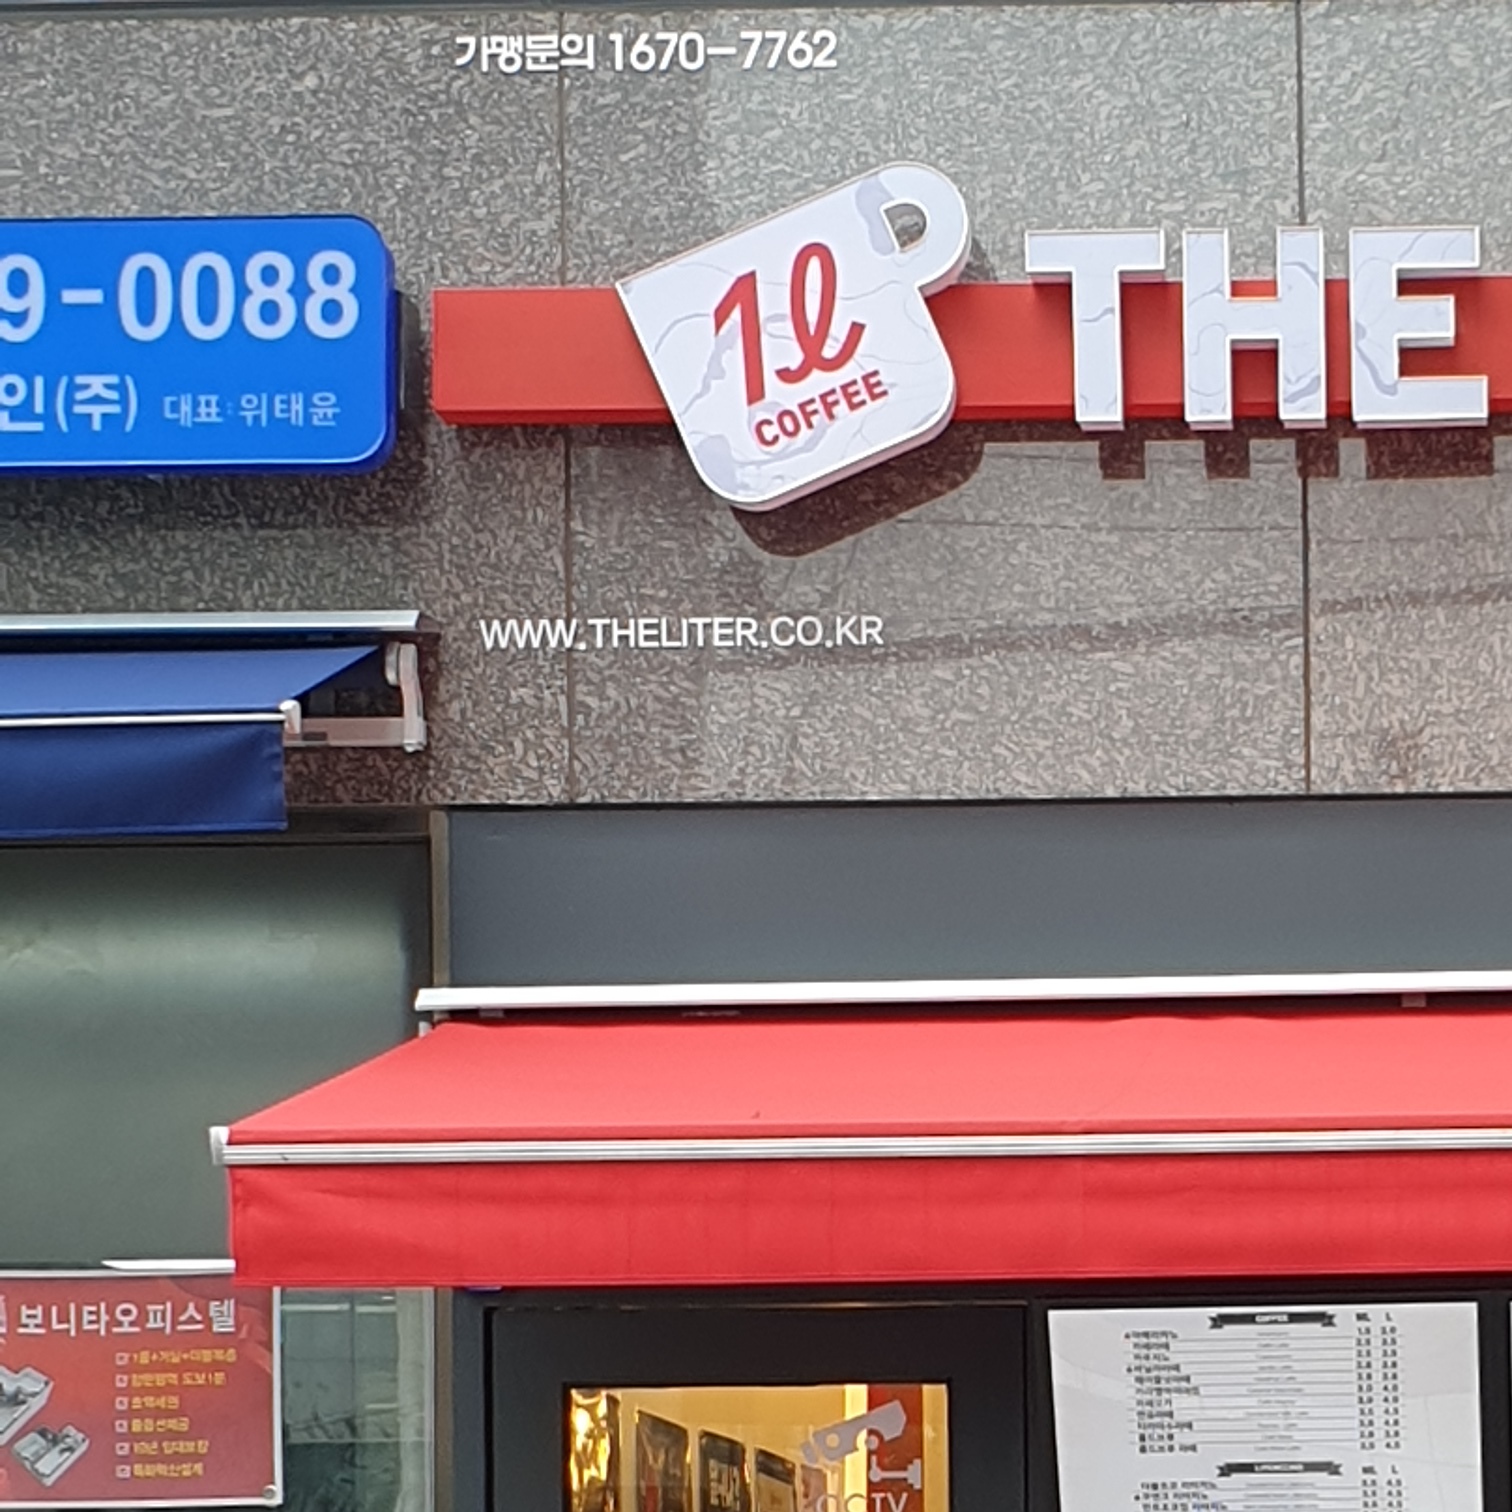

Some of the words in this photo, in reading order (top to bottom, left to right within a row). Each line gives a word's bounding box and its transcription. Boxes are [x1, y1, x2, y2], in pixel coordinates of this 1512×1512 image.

[455, 33, 594, 73] 가맹문의
[608, 31, 838, 71] 1670-7762
[0, 250, 360, 343] 9-0088
[1025, 226, 1489, 430] THE
[239, 390, 341, 428] 위태윤
[753, 369, 890, 449] COFFEE
[479, 616, 885, 650] WWW.THELITER.CO.KR
[16, 1298, 237, 1337] 보니타오피스텔
